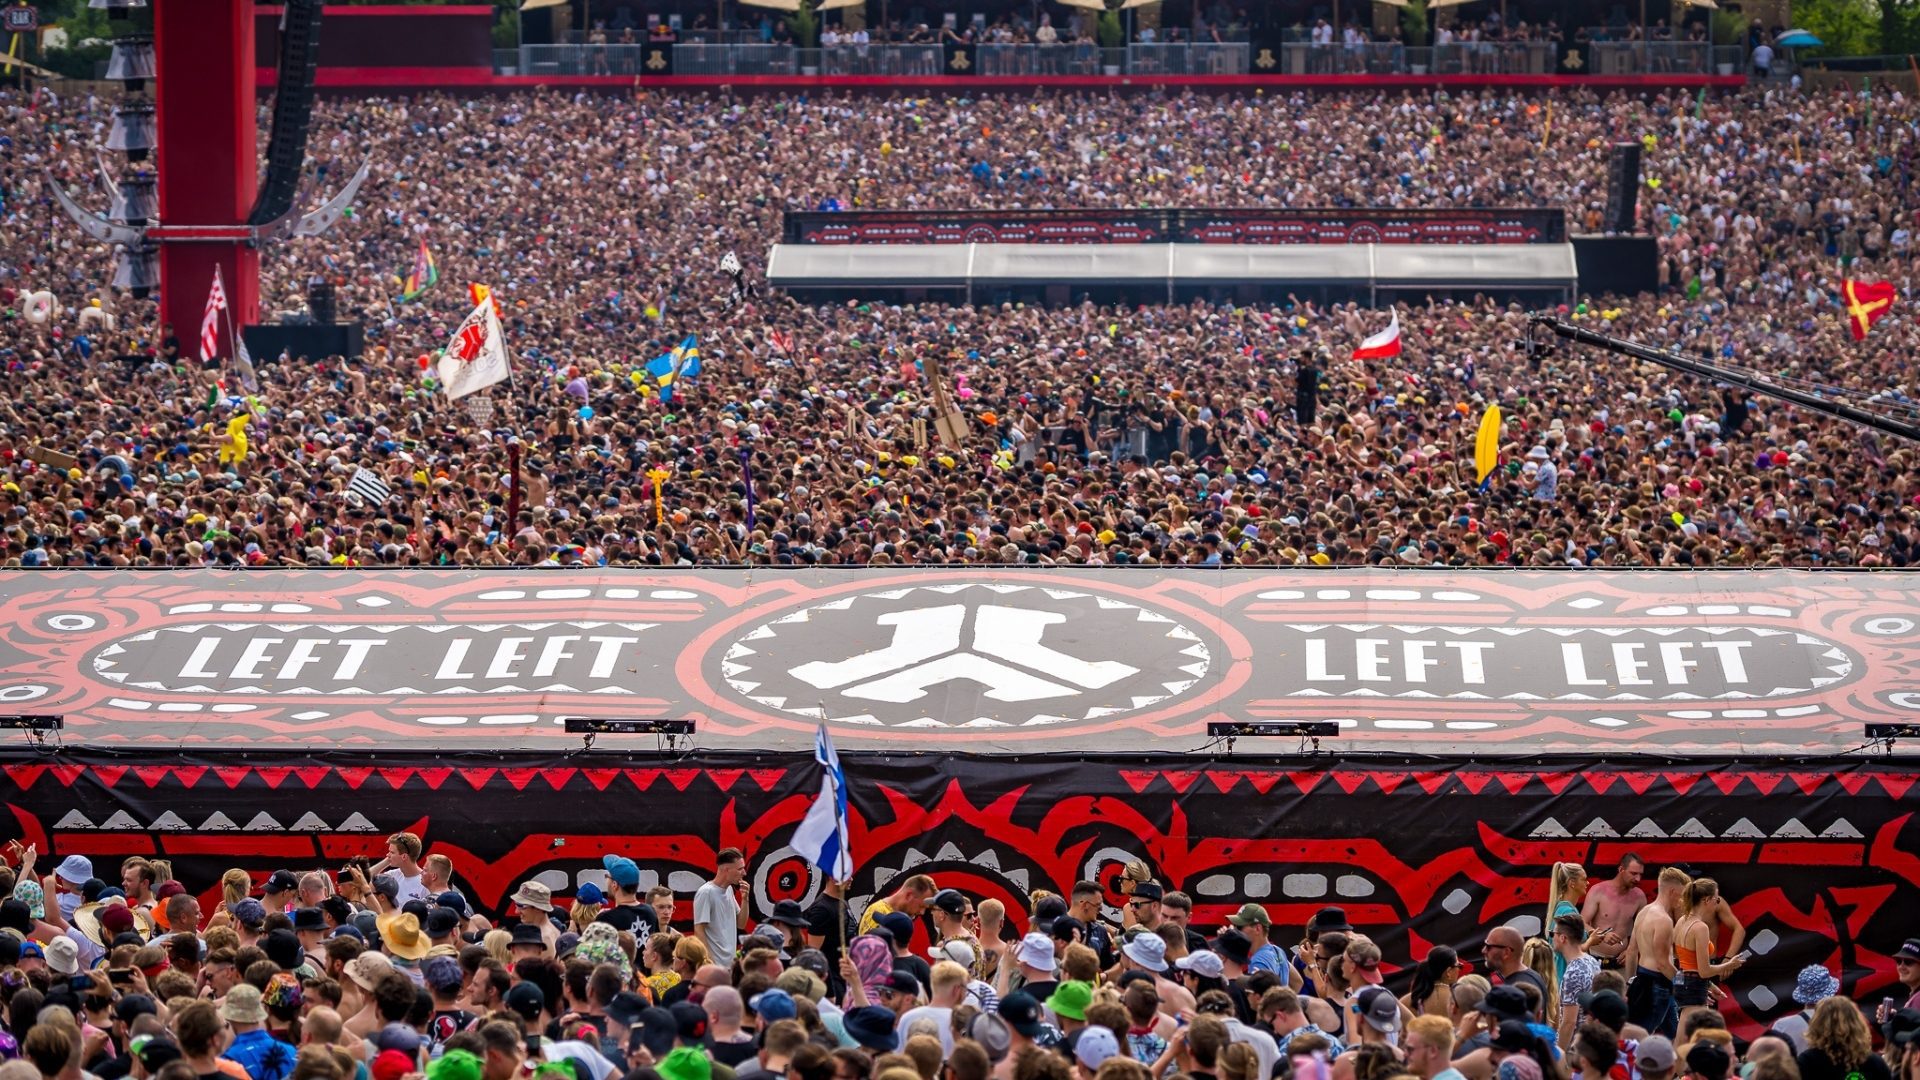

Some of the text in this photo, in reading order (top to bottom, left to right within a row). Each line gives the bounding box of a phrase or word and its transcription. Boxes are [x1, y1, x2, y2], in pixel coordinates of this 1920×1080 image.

[12, 11, 30, 25] BAR
[177, 635, 639, 680] LEFT LEFT
[1305, 638, 1753, 686] LEFT LEFT
